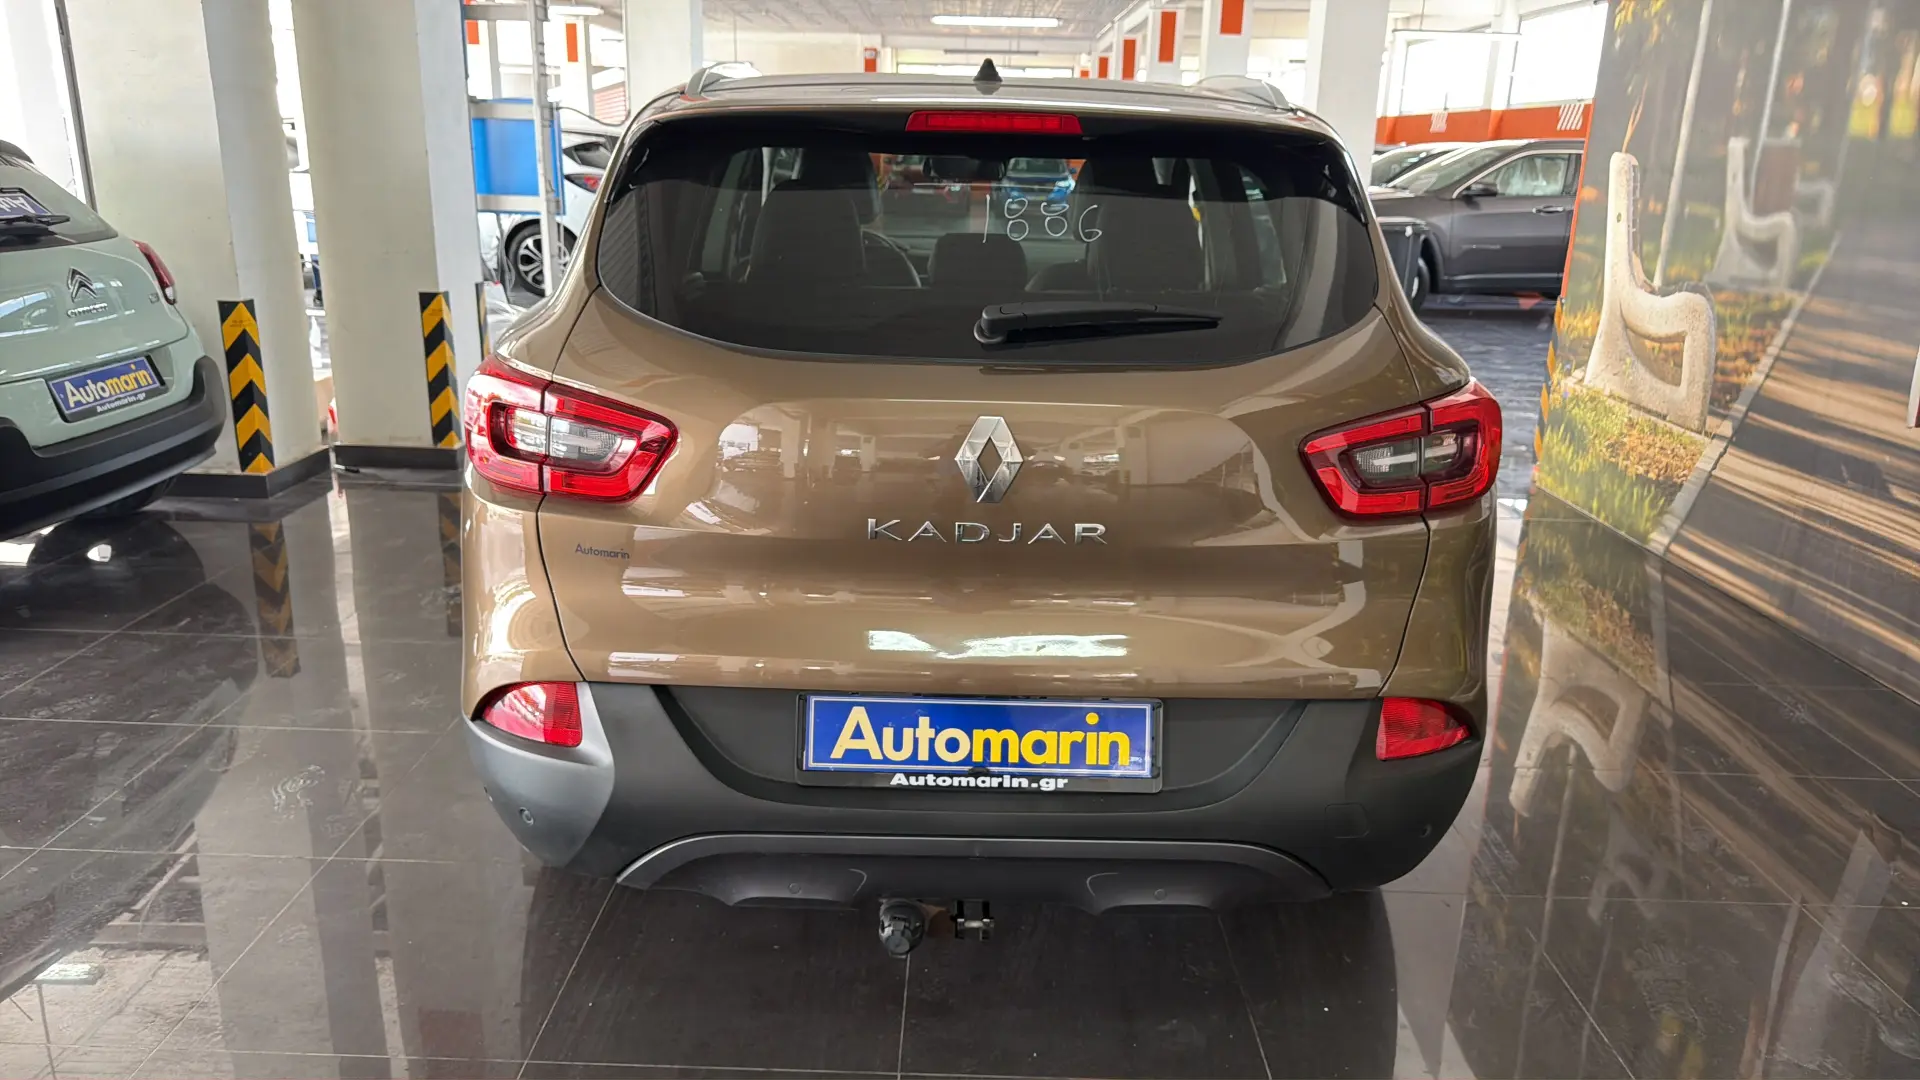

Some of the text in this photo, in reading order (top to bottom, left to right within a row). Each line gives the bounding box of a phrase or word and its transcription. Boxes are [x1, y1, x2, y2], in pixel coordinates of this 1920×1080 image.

[982, 193, 1103, 243] 1886
[64, 363, 153, 408] Automarin
[96, 392, 146, 413] Automarin.gr
[867, 518, 1108, 545] KADJAR
[575, 543, 630, 560] Automarin
[830, 706, 1131, 766] Automarin
[890, 772, 1069, 791] Automarin.gr
